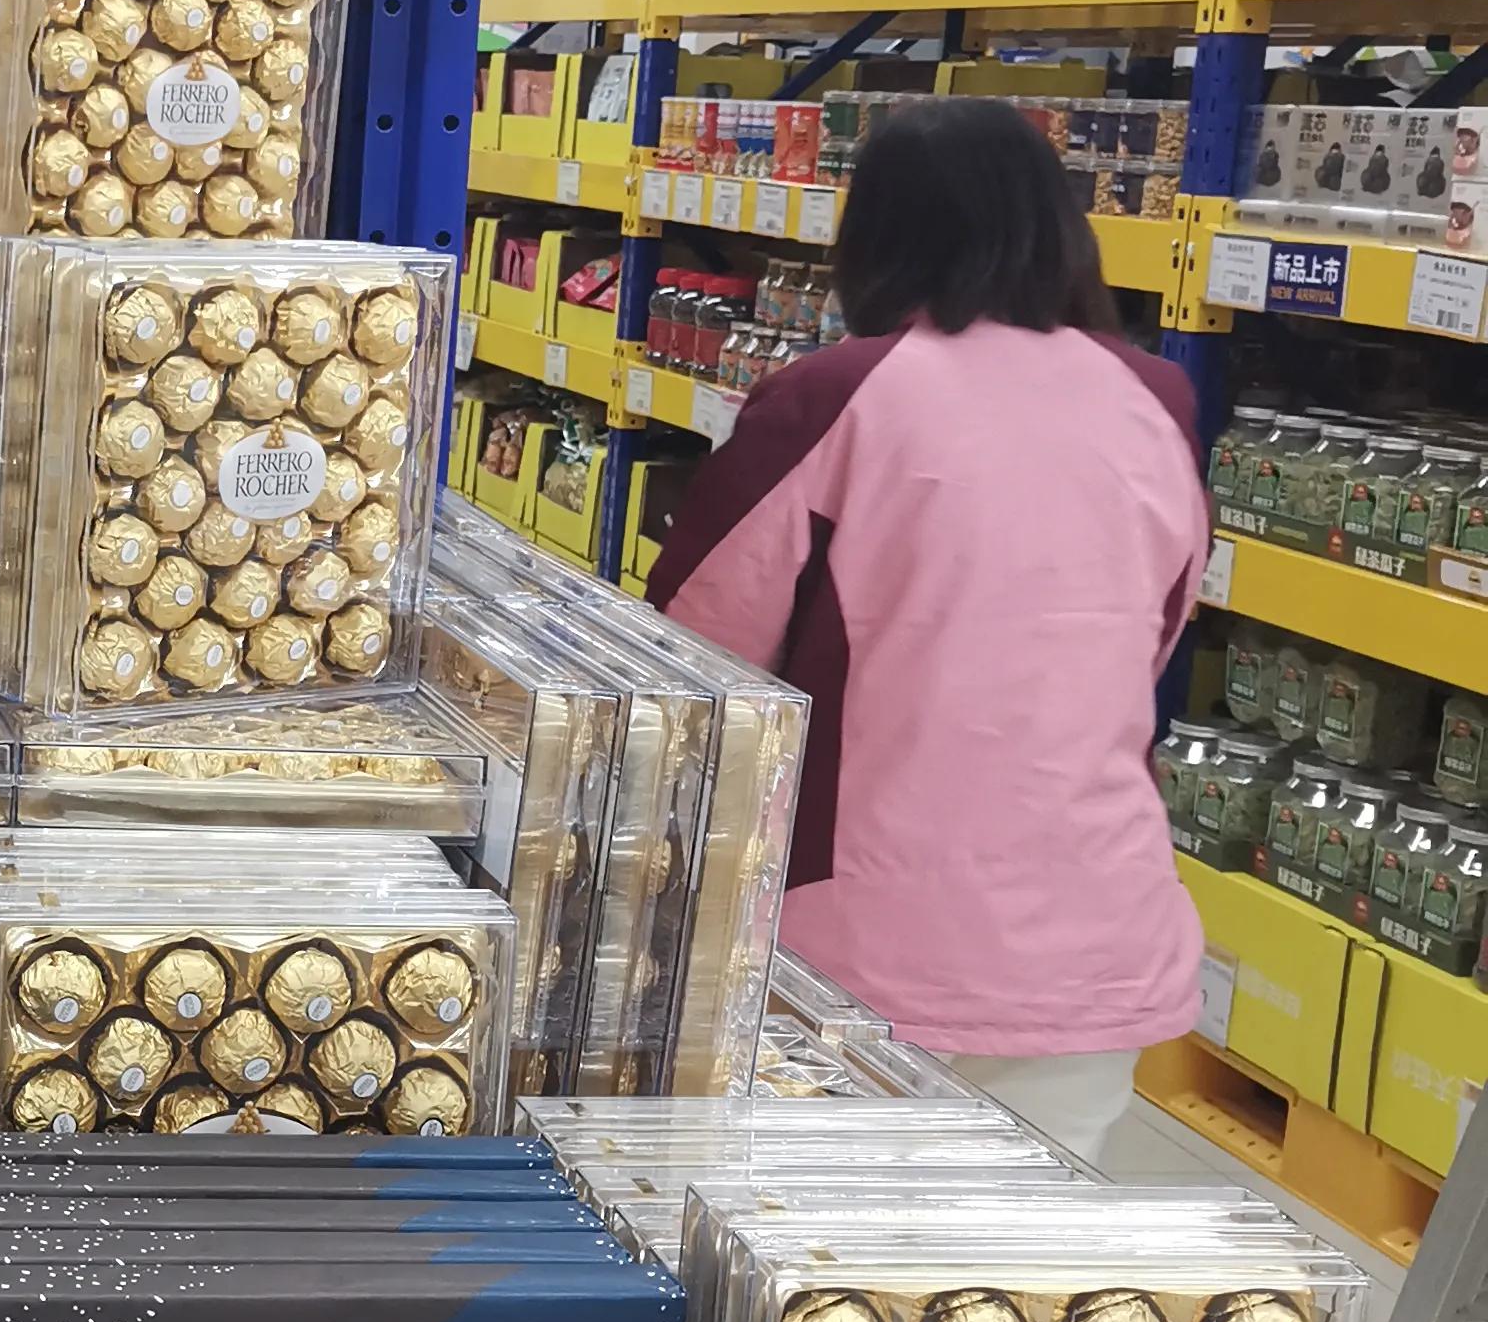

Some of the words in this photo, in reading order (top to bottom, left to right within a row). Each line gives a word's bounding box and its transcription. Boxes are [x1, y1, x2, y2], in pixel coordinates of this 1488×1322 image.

[162, 84, 228, 103] FERRERO
[160, 103, 225, 124] ROCHER
[1274, 253, 1341, 286] 新品上市
[237, 451, 312, 474] FERRERO
[235, 474, 310, 497] ROCHER
